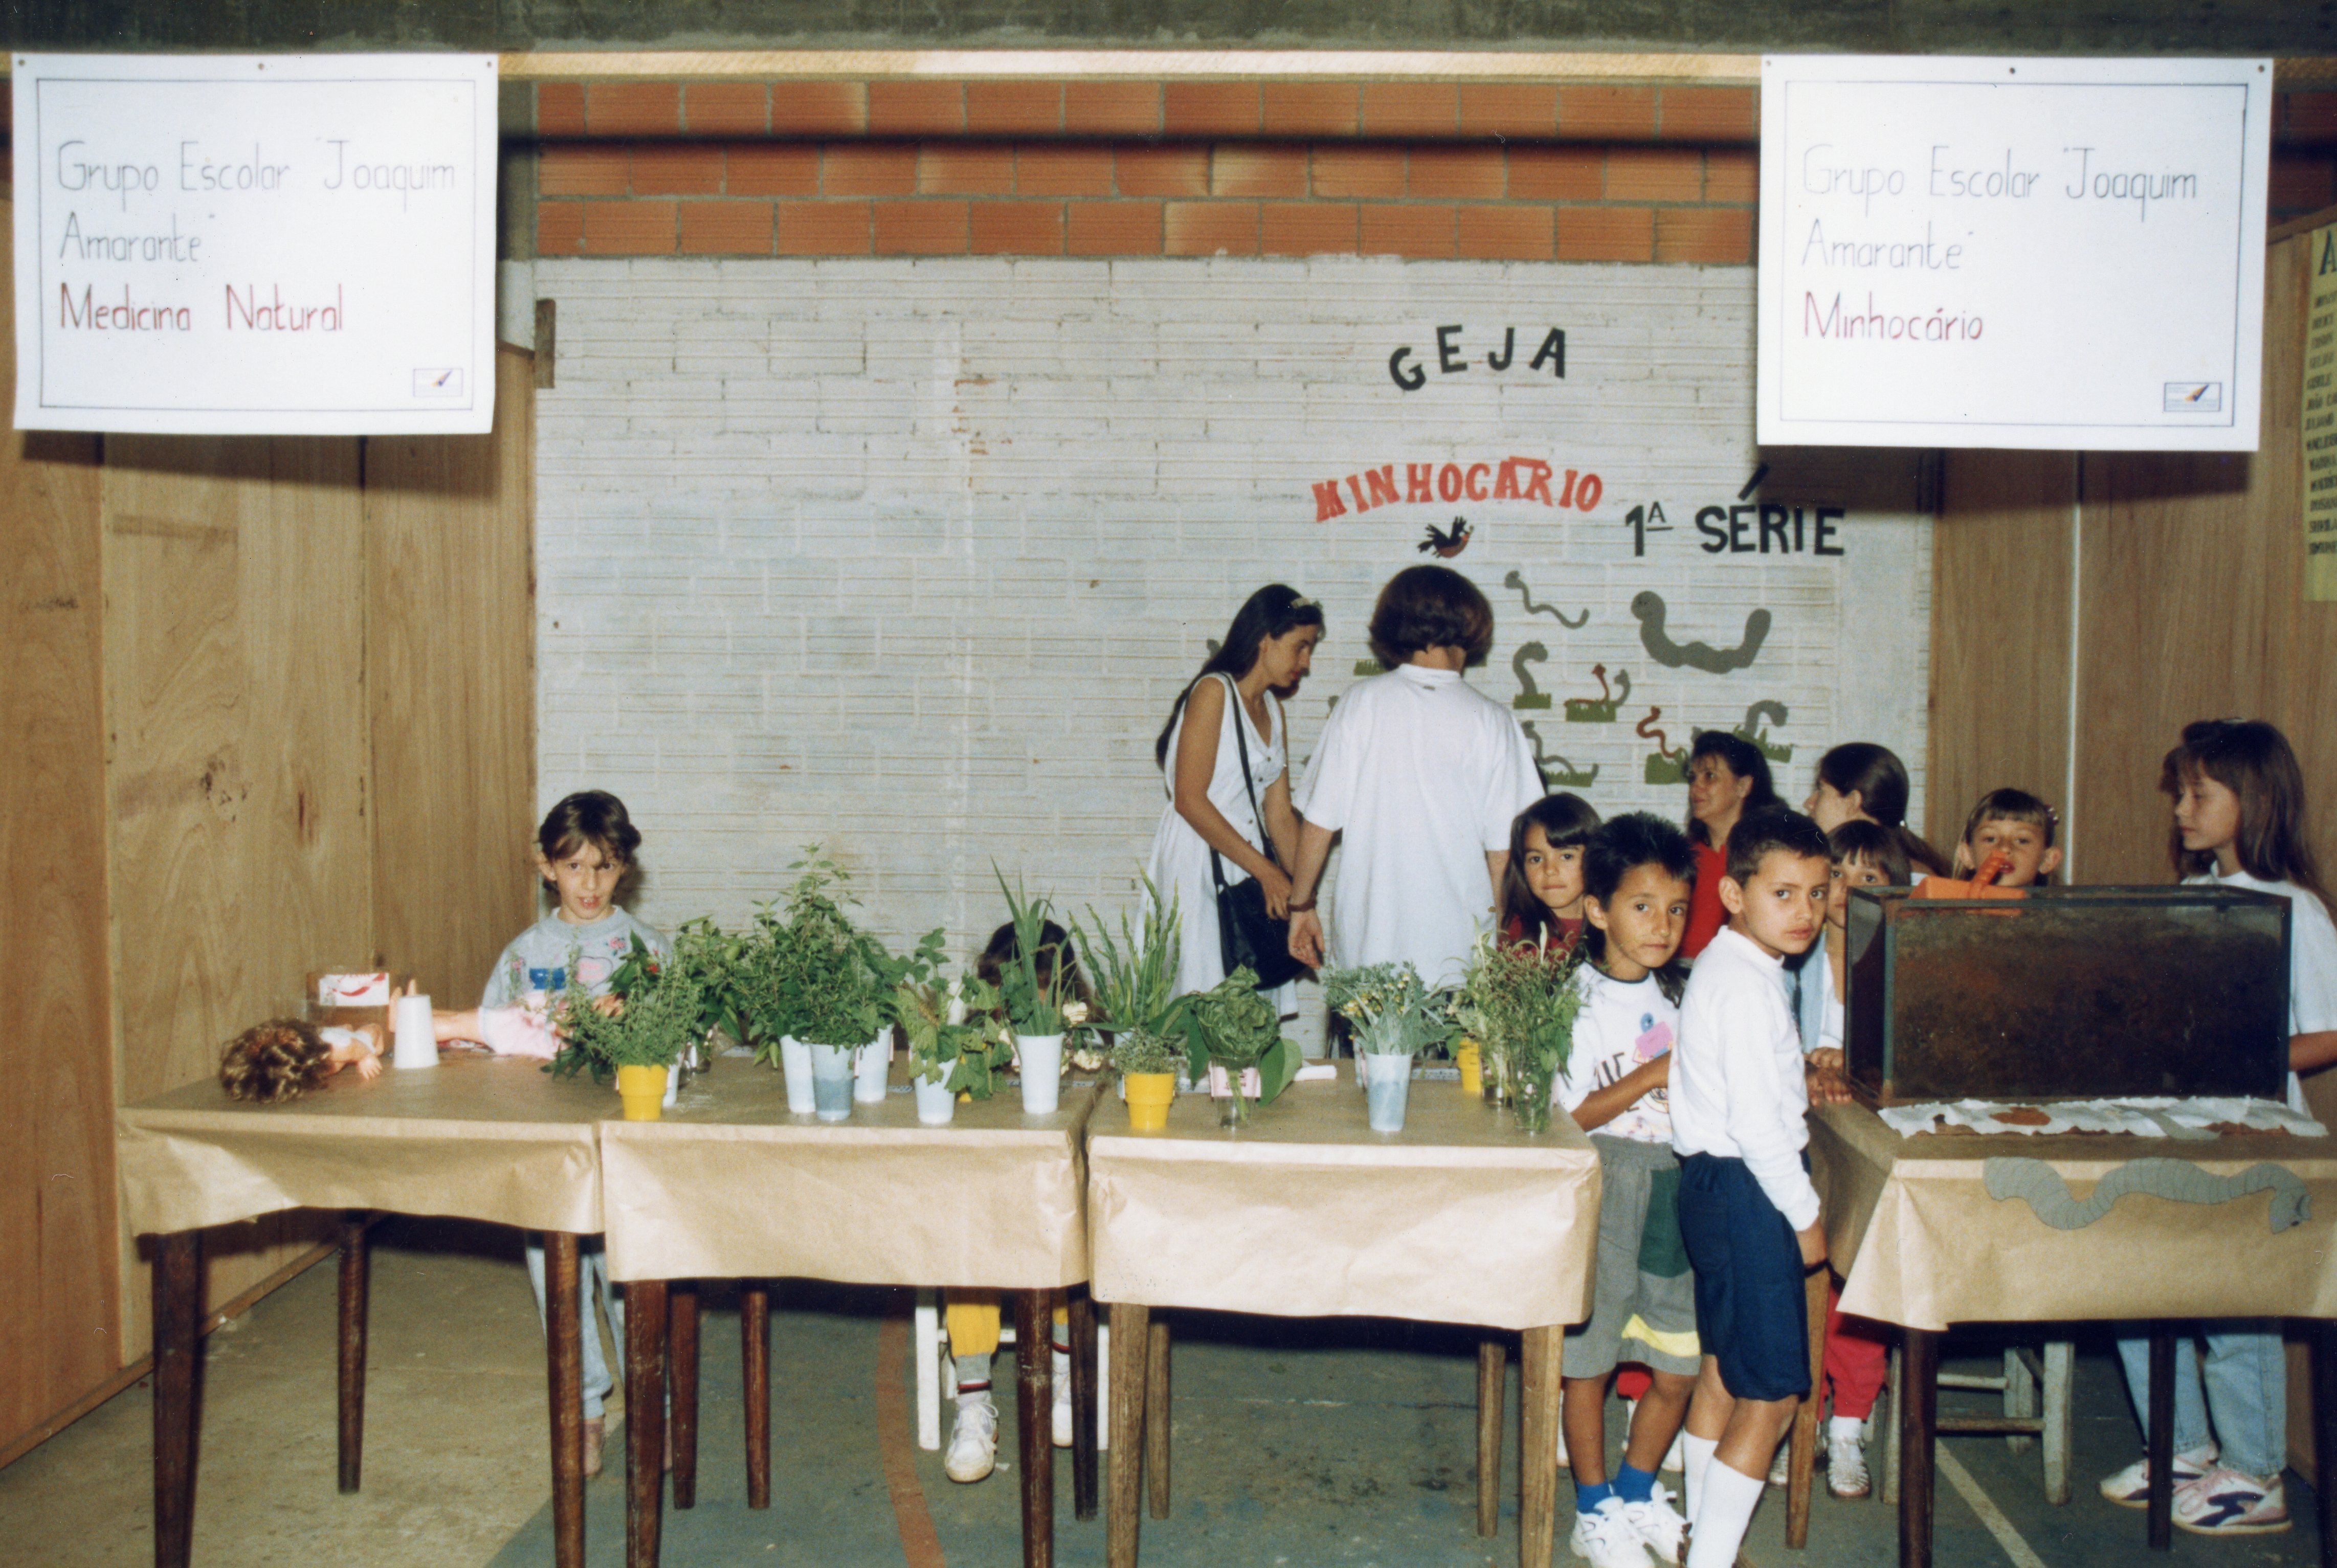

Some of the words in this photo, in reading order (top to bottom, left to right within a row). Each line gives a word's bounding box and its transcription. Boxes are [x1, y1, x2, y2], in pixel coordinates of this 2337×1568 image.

[58, 140, 159, 212] Grupo
[181, 141, 290, 190] Escolar
[1804, 144, 1904, 217] Grupo
[1930, 145, 2040, 197] Escolar
[60, 282, 191, 331] Medicina
[226, 283, 343, 331] Natural
[1805, 290, 1983, 341] Minhocário
[1389, 324, 1565, 391] GEJA
[1695, 463, 1845, 555] SÉRIE
